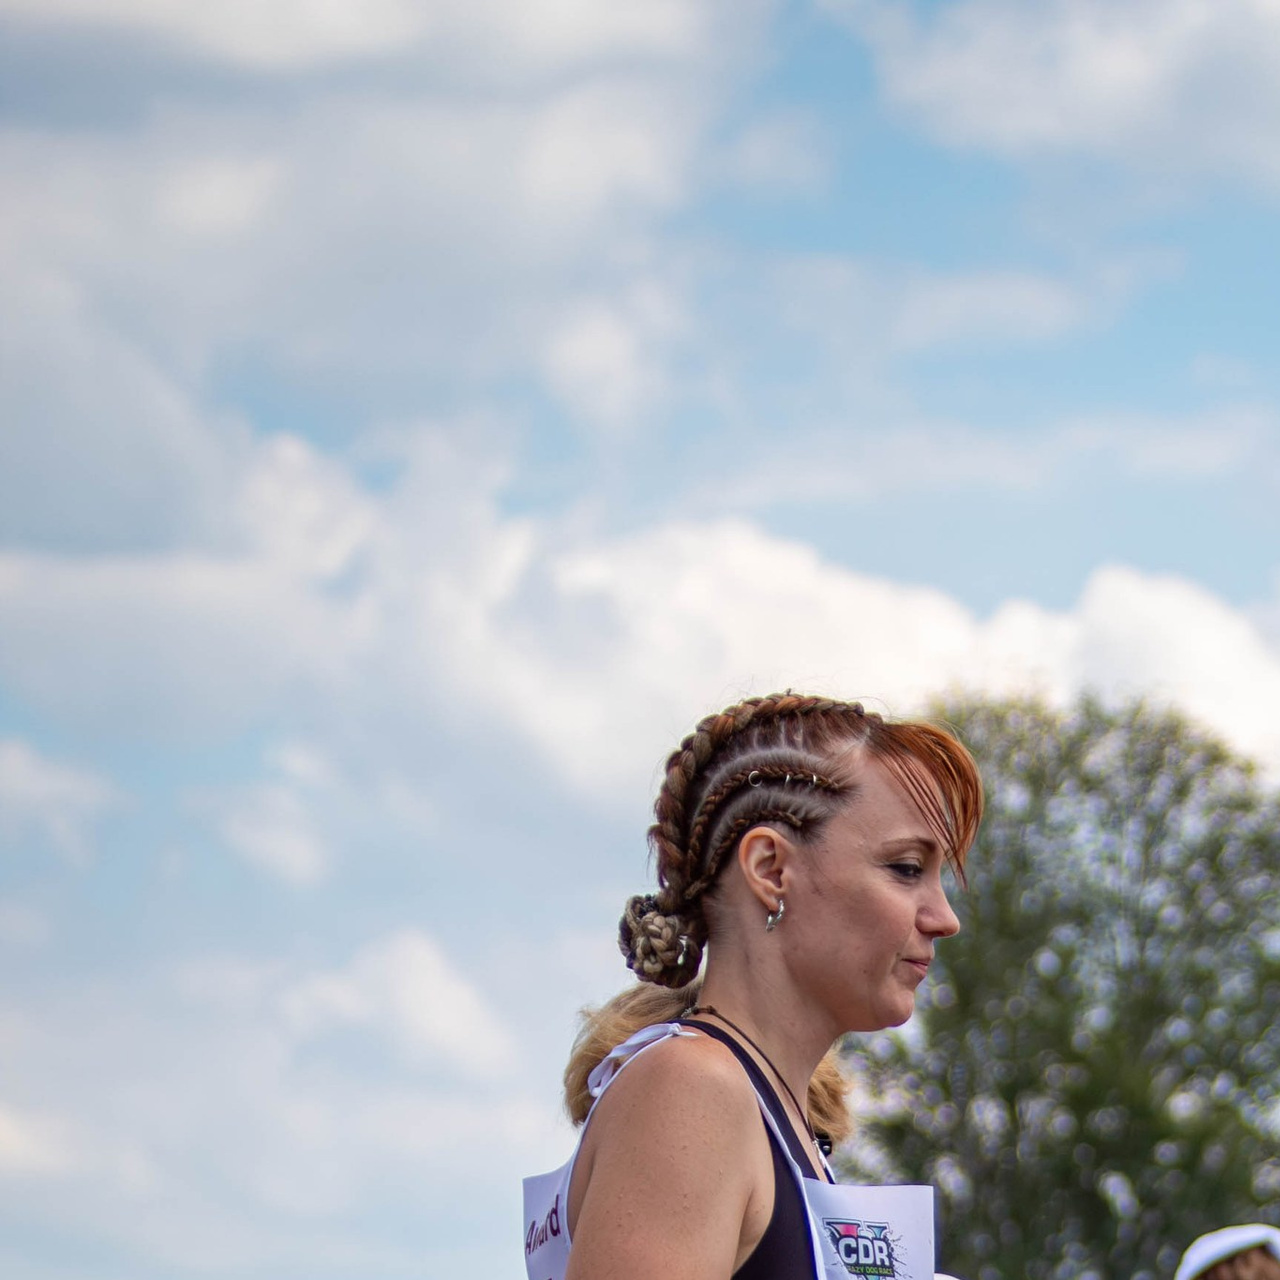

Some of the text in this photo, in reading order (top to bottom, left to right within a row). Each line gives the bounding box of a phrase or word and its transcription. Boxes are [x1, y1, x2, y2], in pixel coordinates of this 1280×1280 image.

[838, 1236, 890, 1266] CDR
[865, 1266, 878, 1274] DOG
[879, 1267, 893, 1275] RACE
